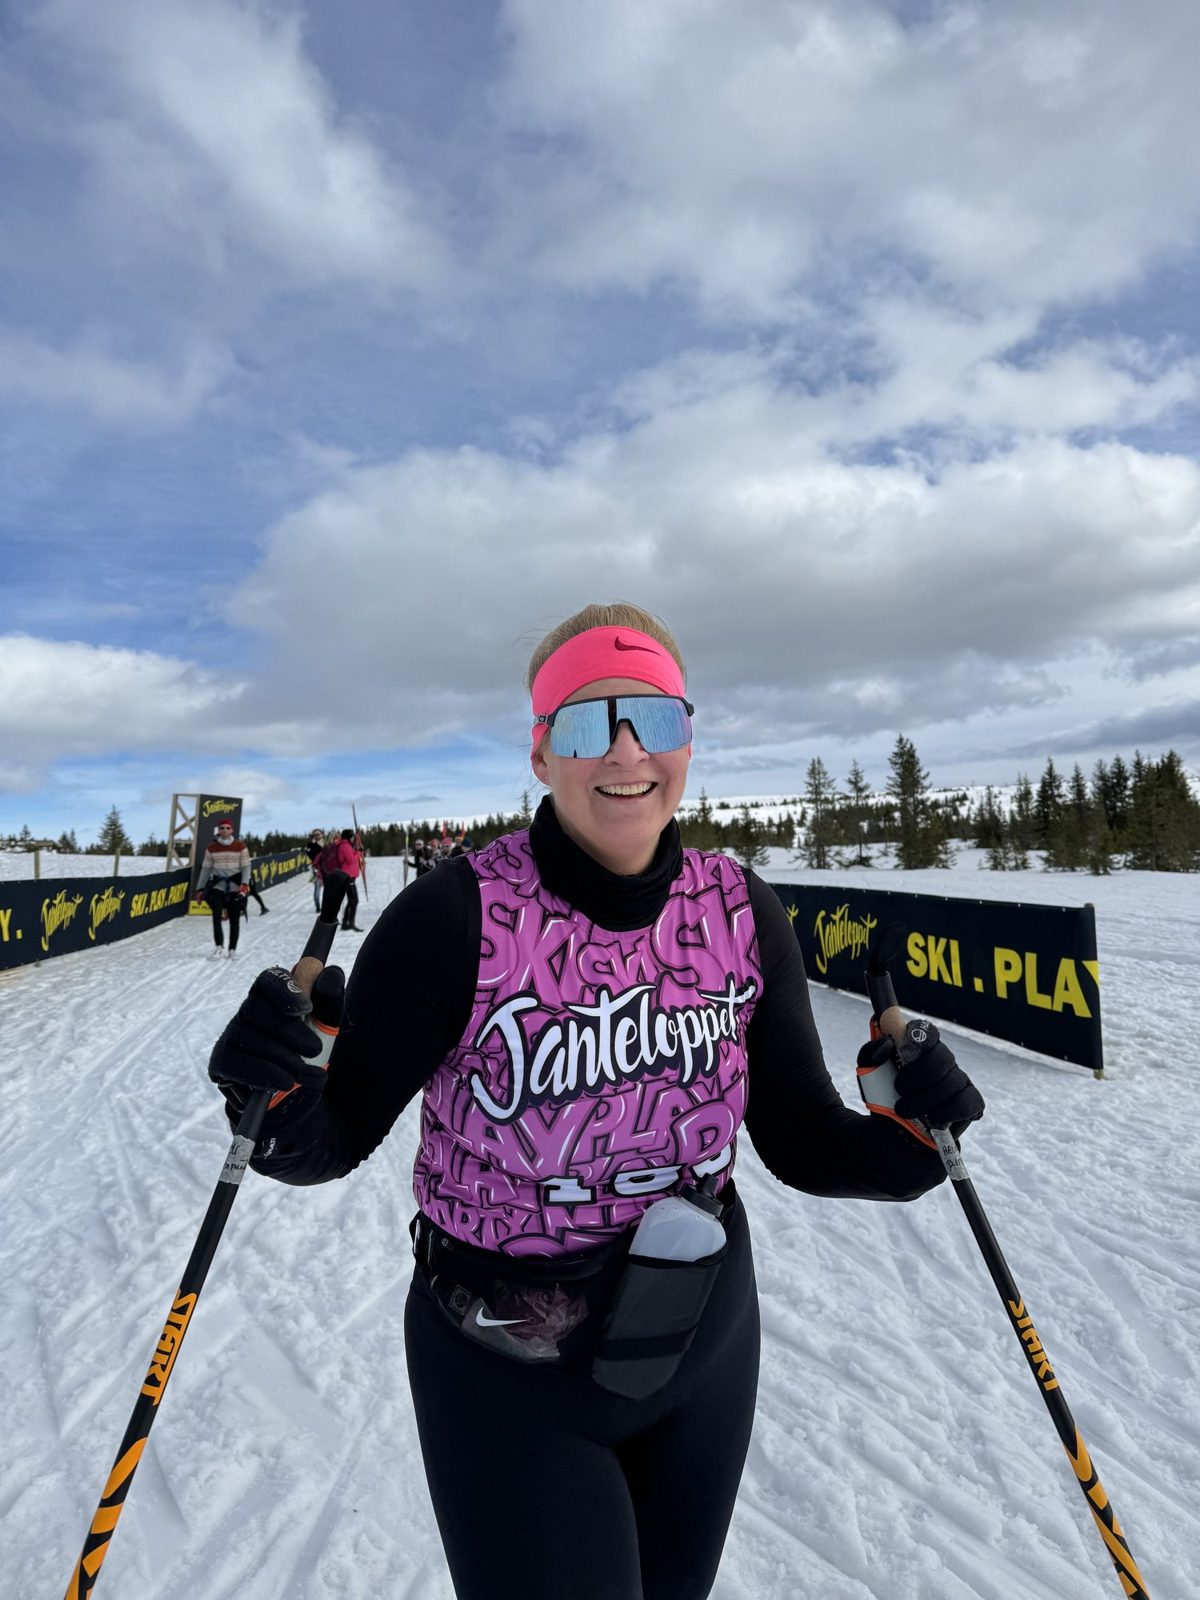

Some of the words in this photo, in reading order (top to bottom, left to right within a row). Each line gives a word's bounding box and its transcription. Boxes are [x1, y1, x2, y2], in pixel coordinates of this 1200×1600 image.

[815, 903, 878, 974] Janteloppet
[471, 982, 757, 1120] Janteloppet
[142, 1290, 197, 1406] START
